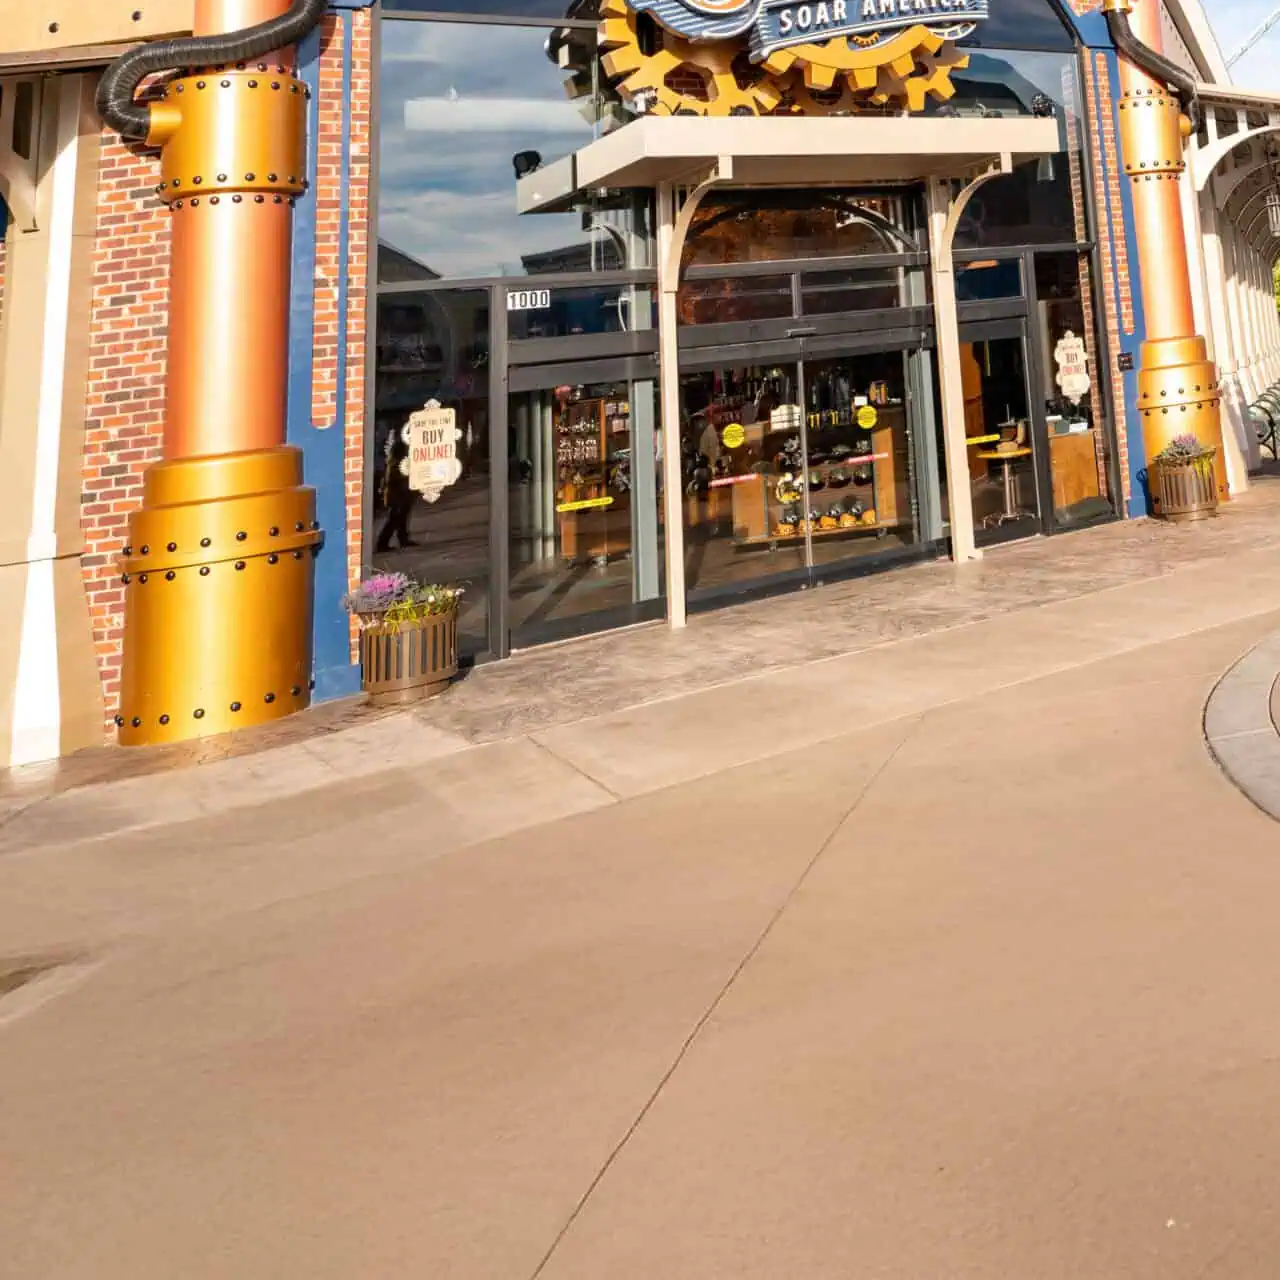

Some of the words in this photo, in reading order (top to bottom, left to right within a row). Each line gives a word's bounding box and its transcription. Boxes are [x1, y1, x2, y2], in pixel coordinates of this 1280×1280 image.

[779, 0, 847, 33] SOAR
[510, 291, 547, 309] 1000
[422, 428, 444, 445] BUY
[413, 444, 453, 464] ONLINE!
